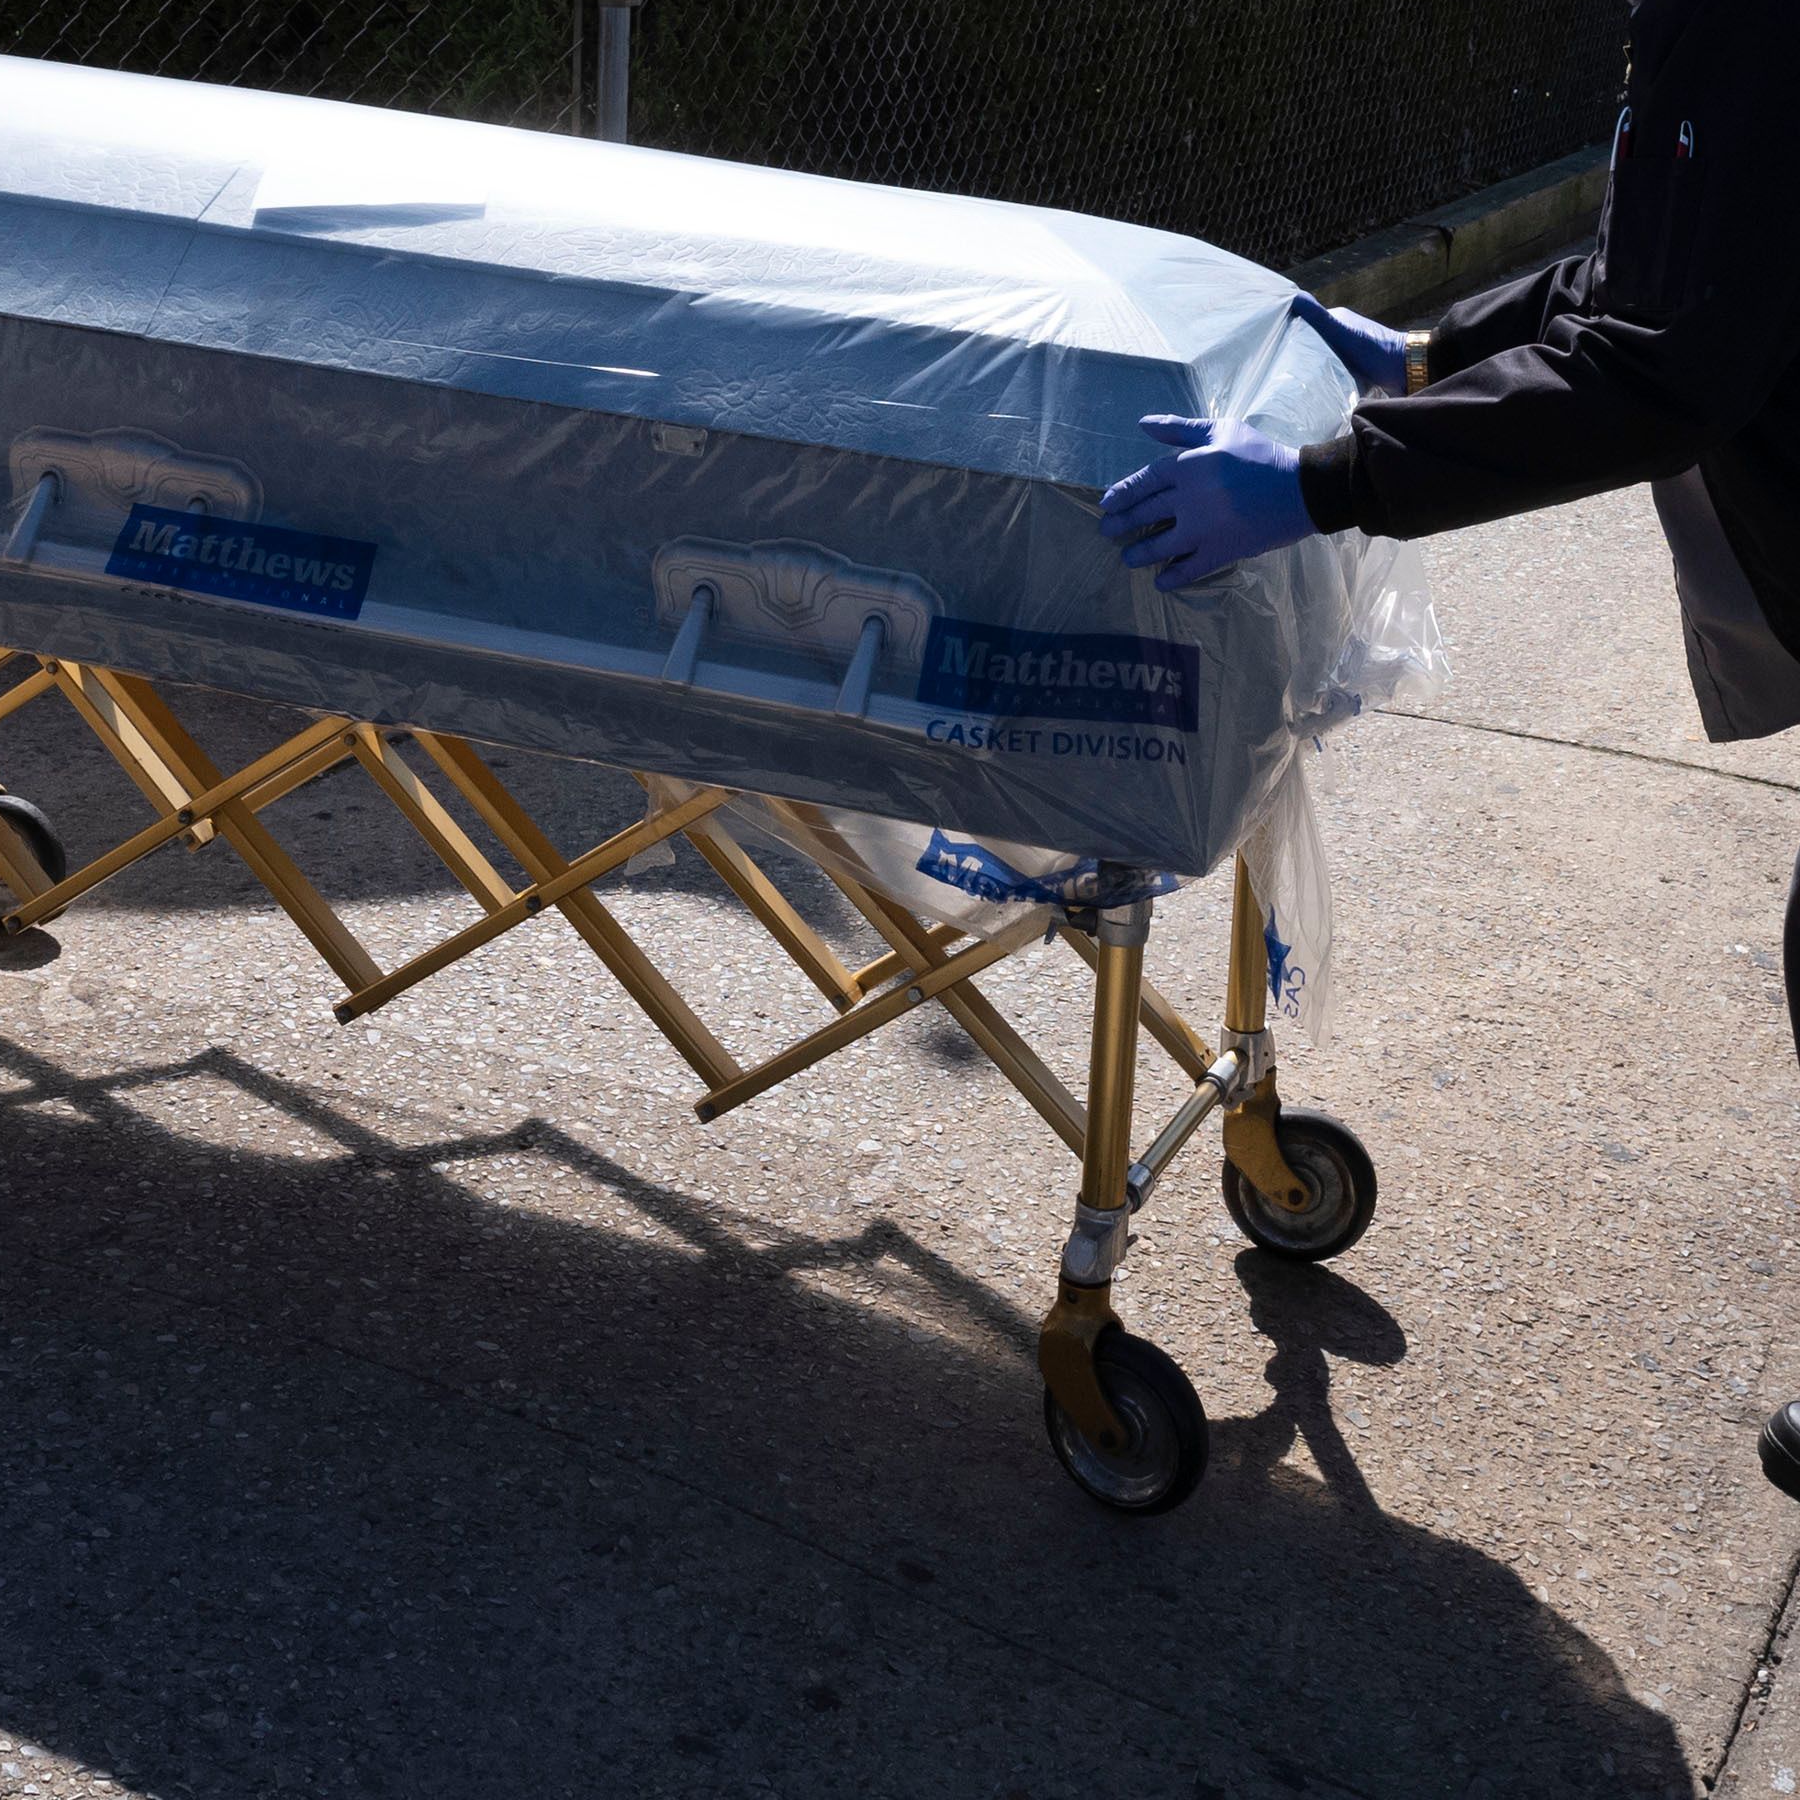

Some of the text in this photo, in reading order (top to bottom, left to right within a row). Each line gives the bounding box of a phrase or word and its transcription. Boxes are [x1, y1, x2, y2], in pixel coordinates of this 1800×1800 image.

[128, 520, 357, 592] Matthews
[938, 635, 1184, 699] Matthews
[925, 719, 1186, 765] CASKET DIVISION
